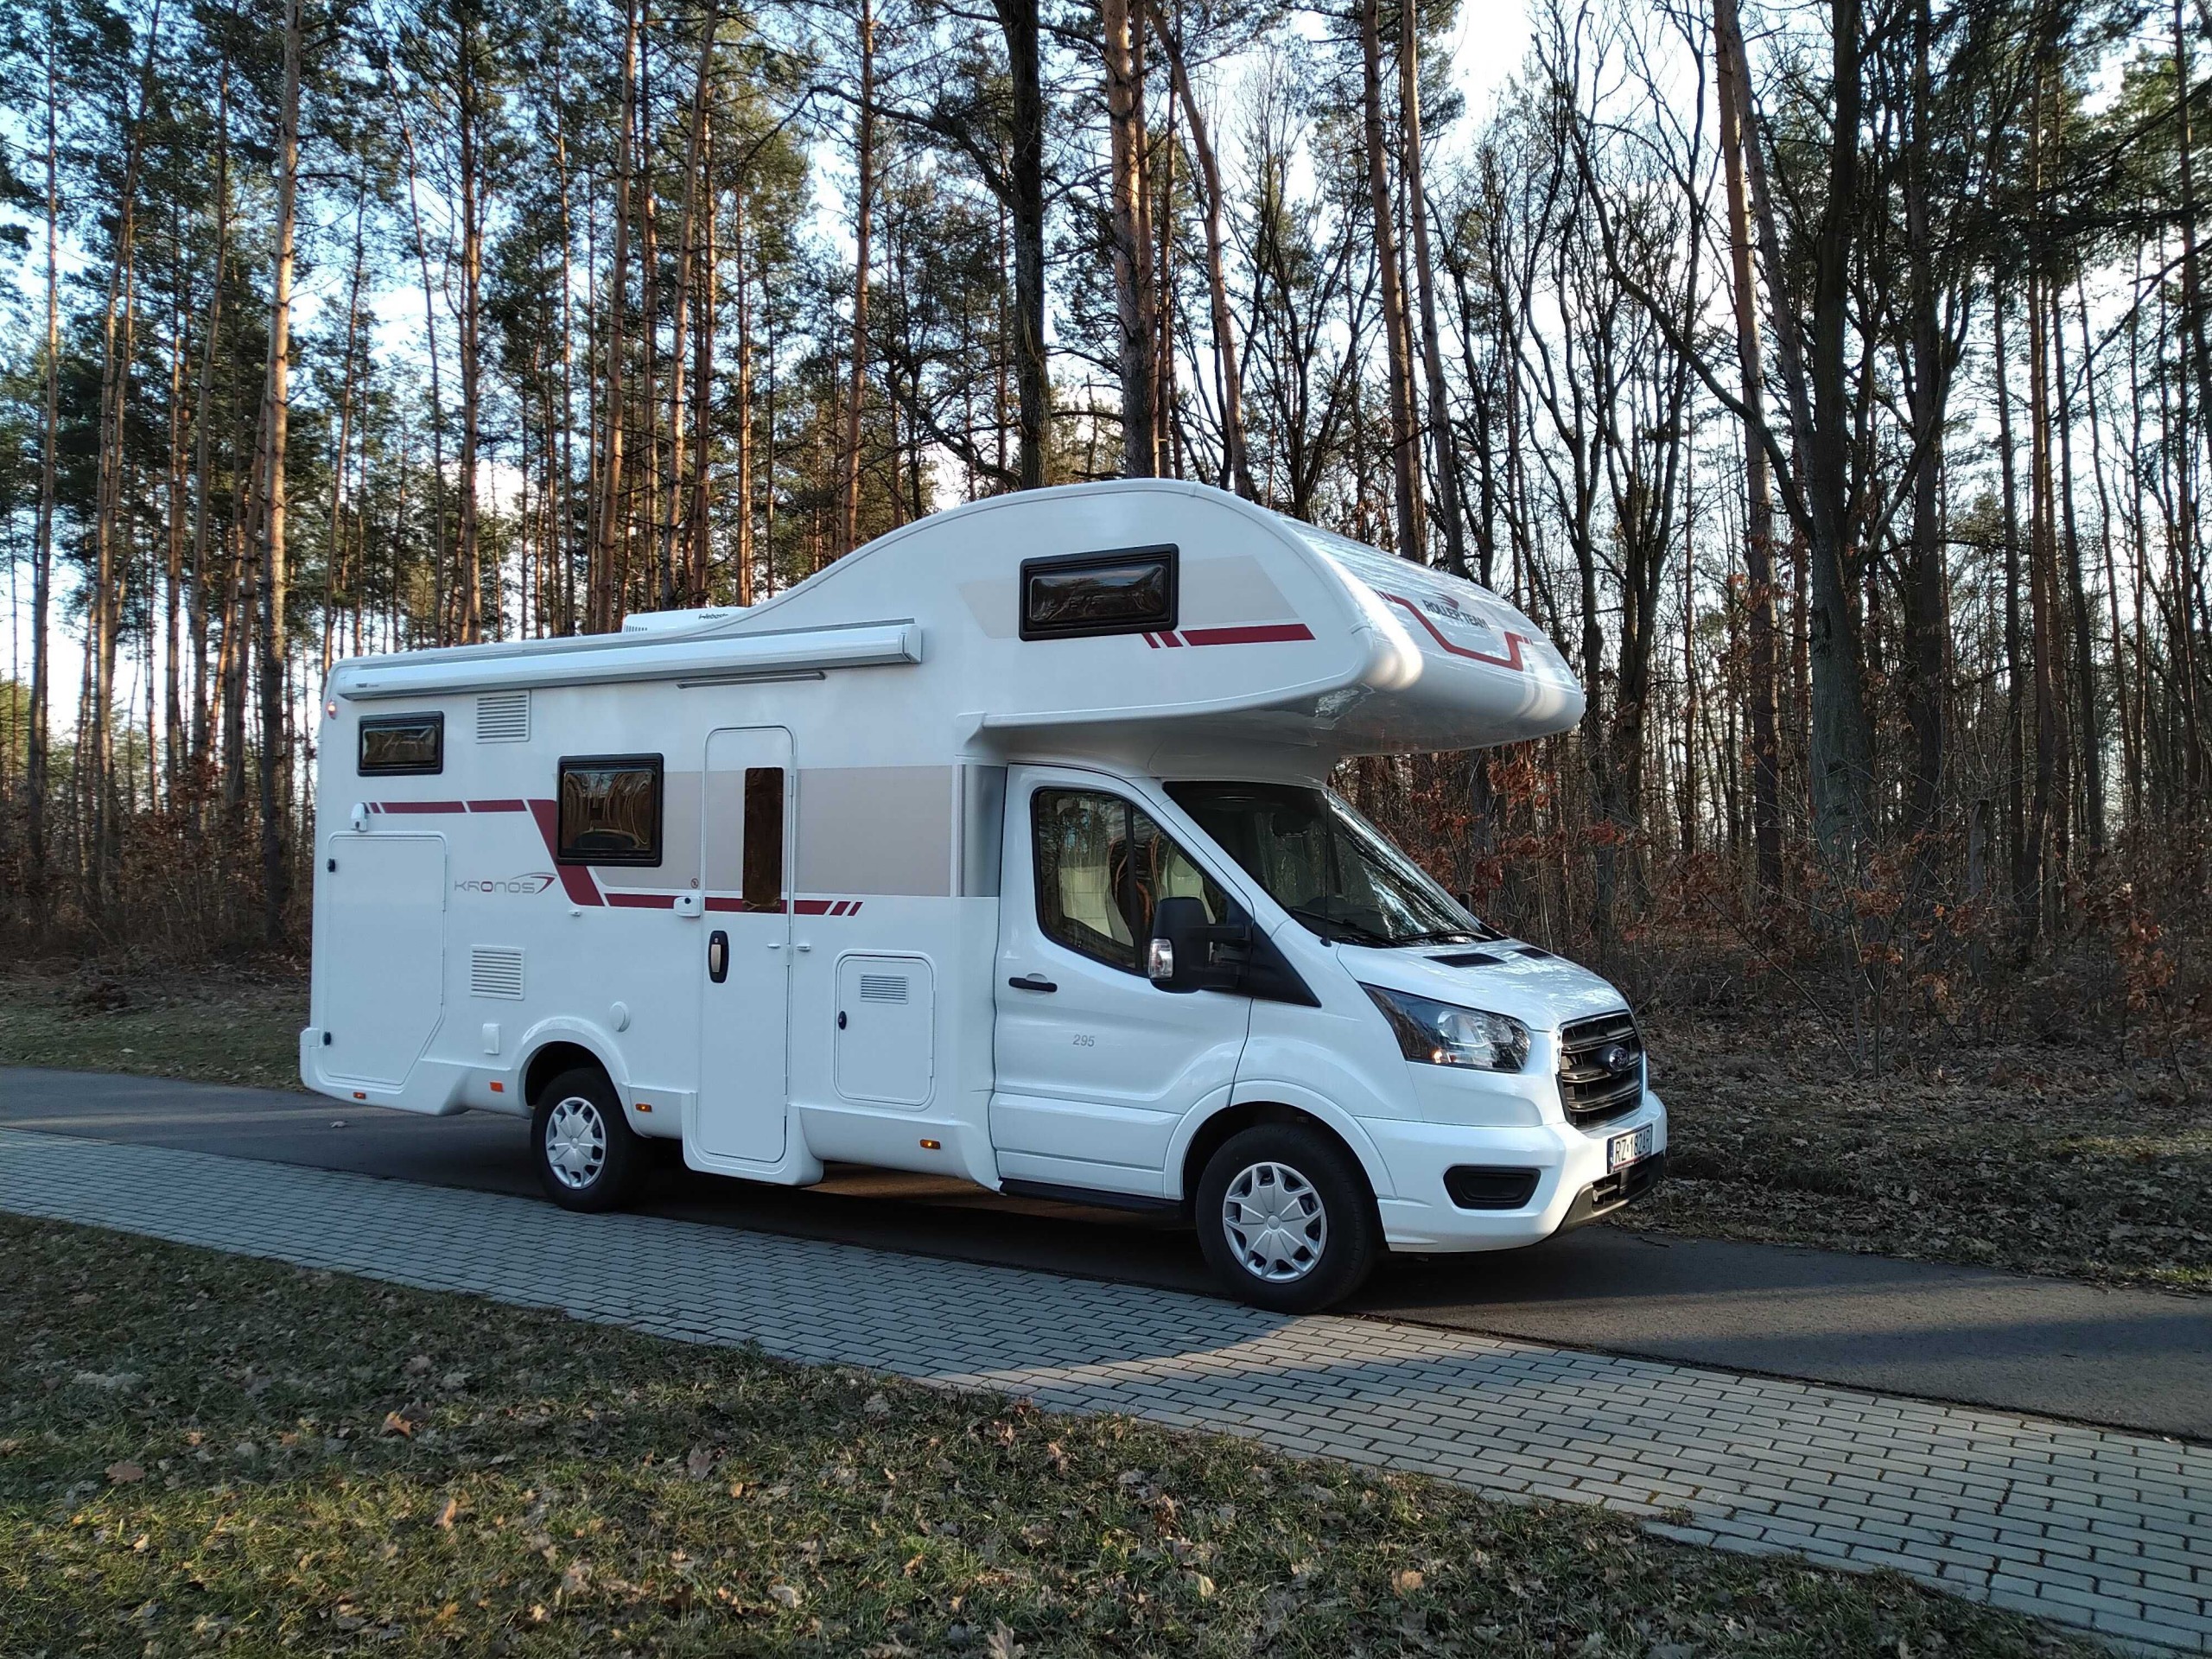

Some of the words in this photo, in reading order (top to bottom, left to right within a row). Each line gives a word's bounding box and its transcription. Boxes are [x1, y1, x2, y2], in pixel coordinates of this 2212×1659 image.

[1422, 599, 1463, 622] ROLLER
[1460, 612, 1491, 631] TEAM
[454, 880, 535, 893] KRONOS
[1073, 1033, 1095, 1047] 295
